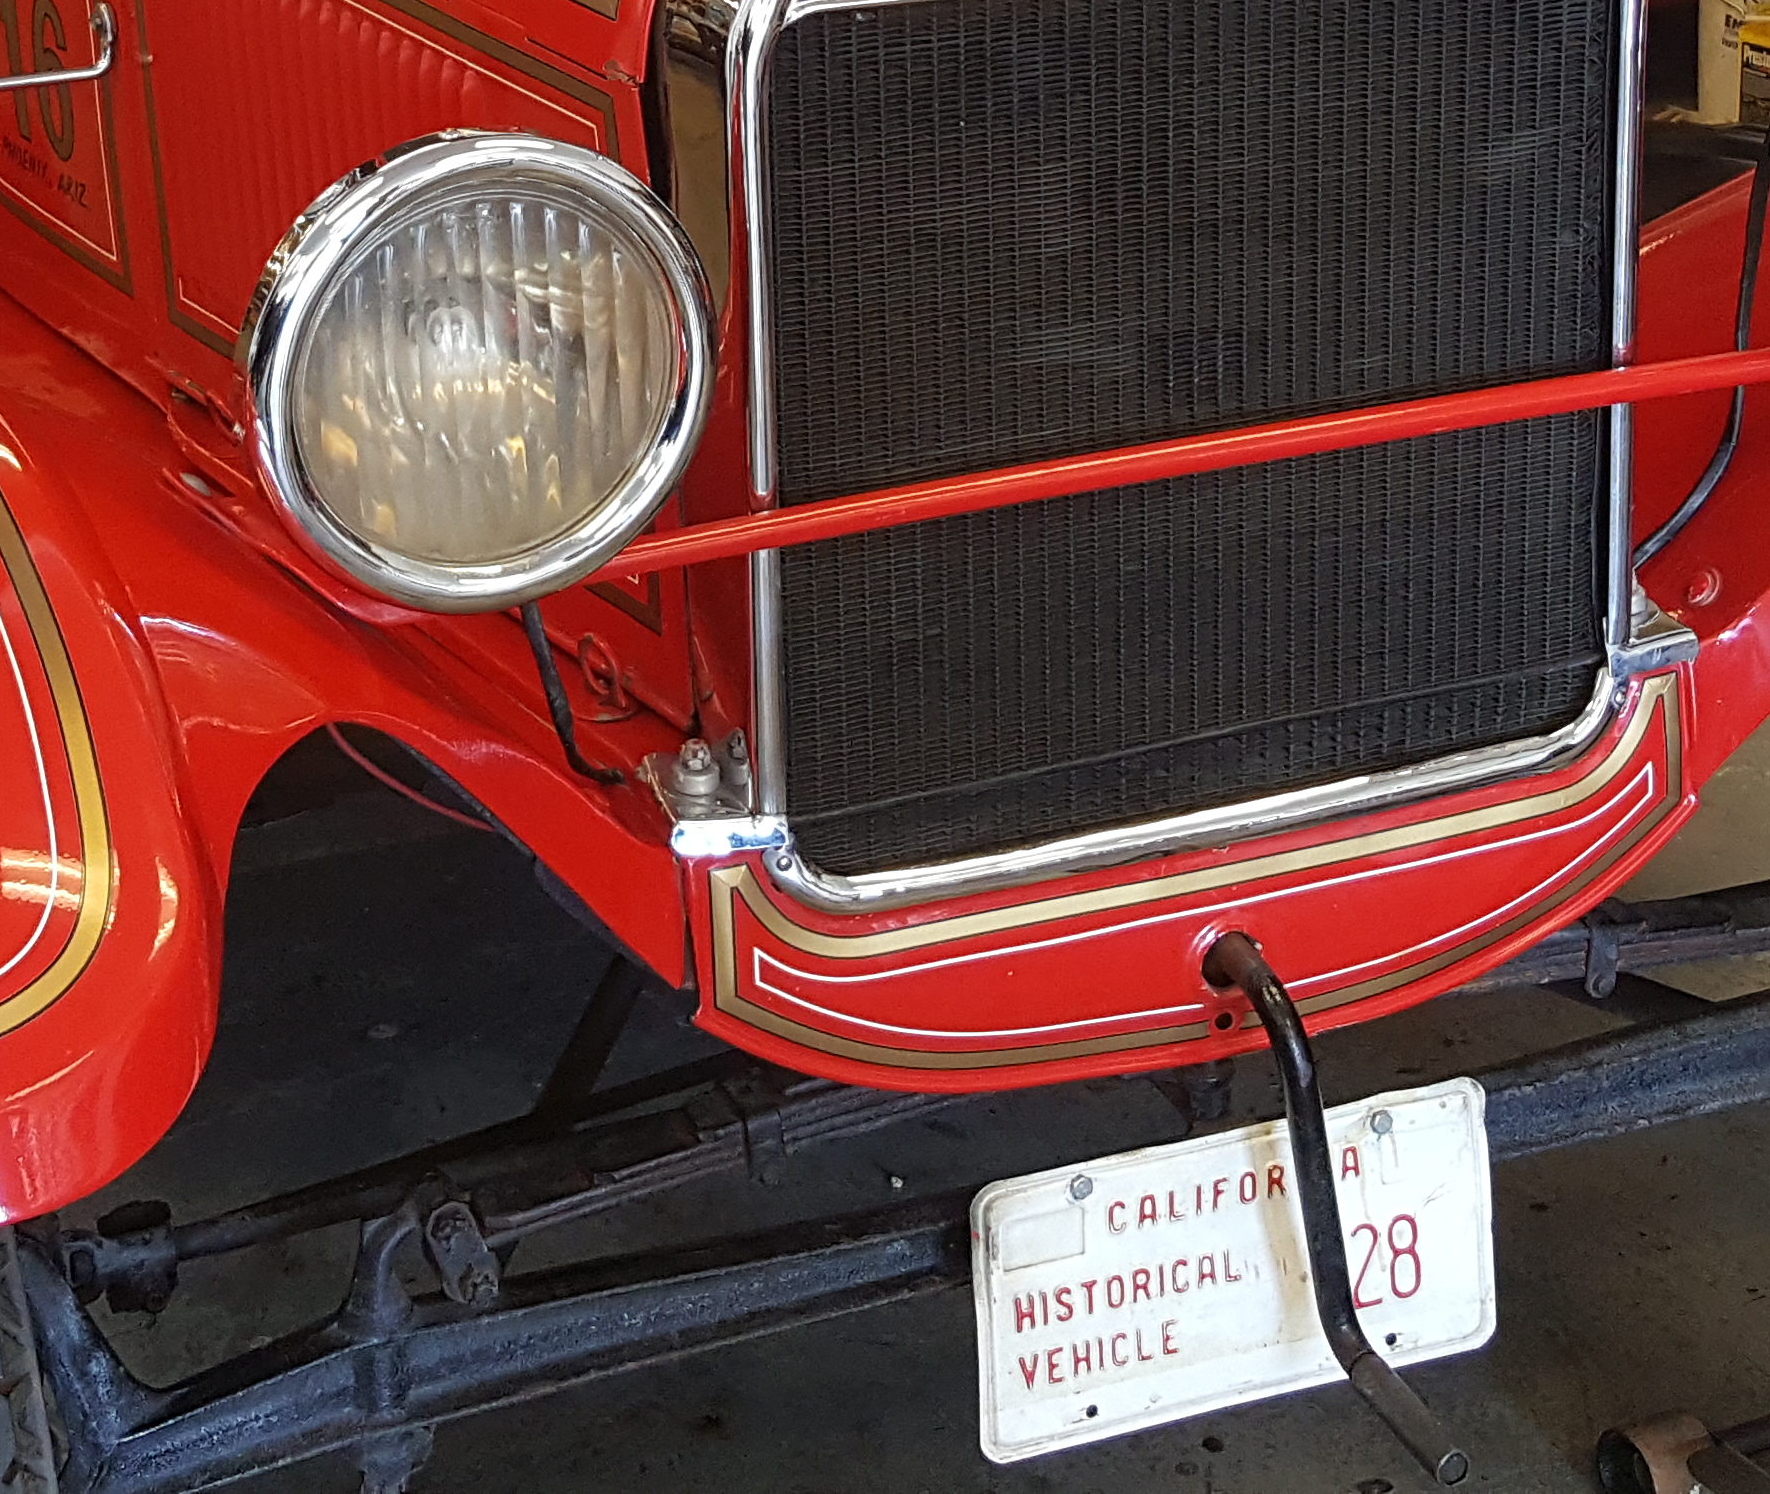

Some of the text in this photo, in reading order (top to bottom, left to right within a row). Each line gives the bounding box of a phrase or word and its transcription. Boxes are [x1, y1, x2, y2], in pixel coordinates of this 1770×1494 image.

[1106, 1144, 1361, 1235] CALIFORA
[1013, 1247, 1242, 1334] HISTORICAL
[1017, 1317, 1181, 1391] VEHICLE
